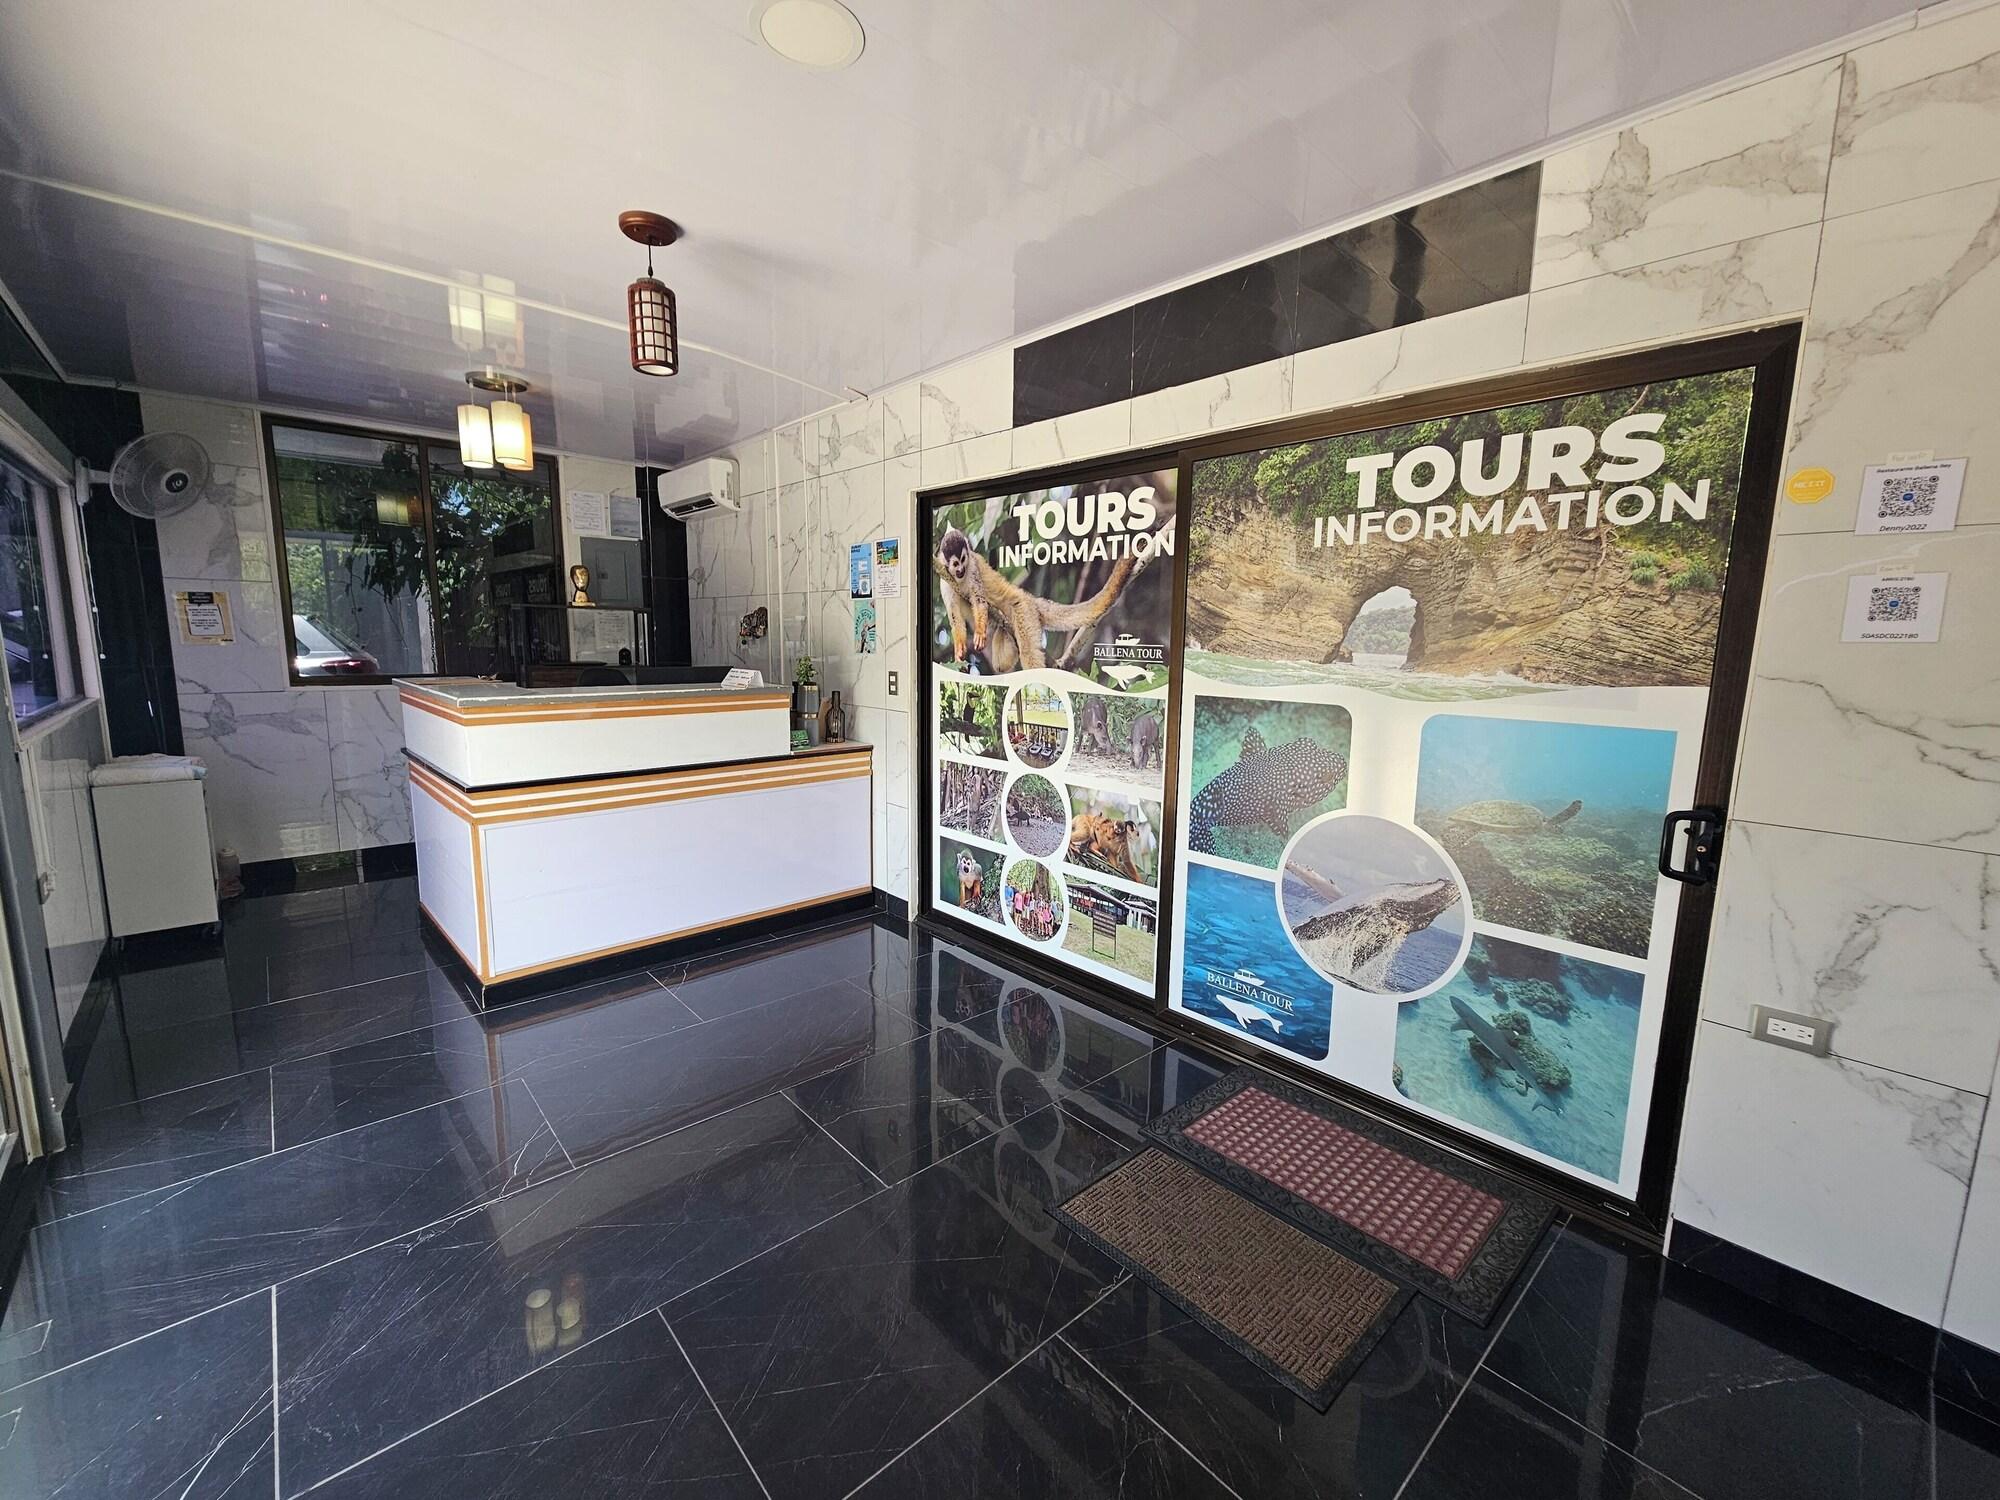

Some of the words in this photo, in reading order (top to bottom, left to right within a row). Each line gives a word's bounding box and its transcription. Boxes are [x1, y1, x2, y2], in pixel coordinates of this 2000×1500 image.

[1346, 413, 1666, 509] TOURS
[1013, 486, 1157, 541] TOURS
[1313, 479, 1711, 549] INFORMATION
[999, 530, 1176, 568] INFORMATION
[1094, 647, 1136, 658] BALLENA
[1137, 648, 1163, 659] TOUR
[1207, 971, 1259, 999] BALLENA
[1260, 990, 1294, 1012] TOUR
